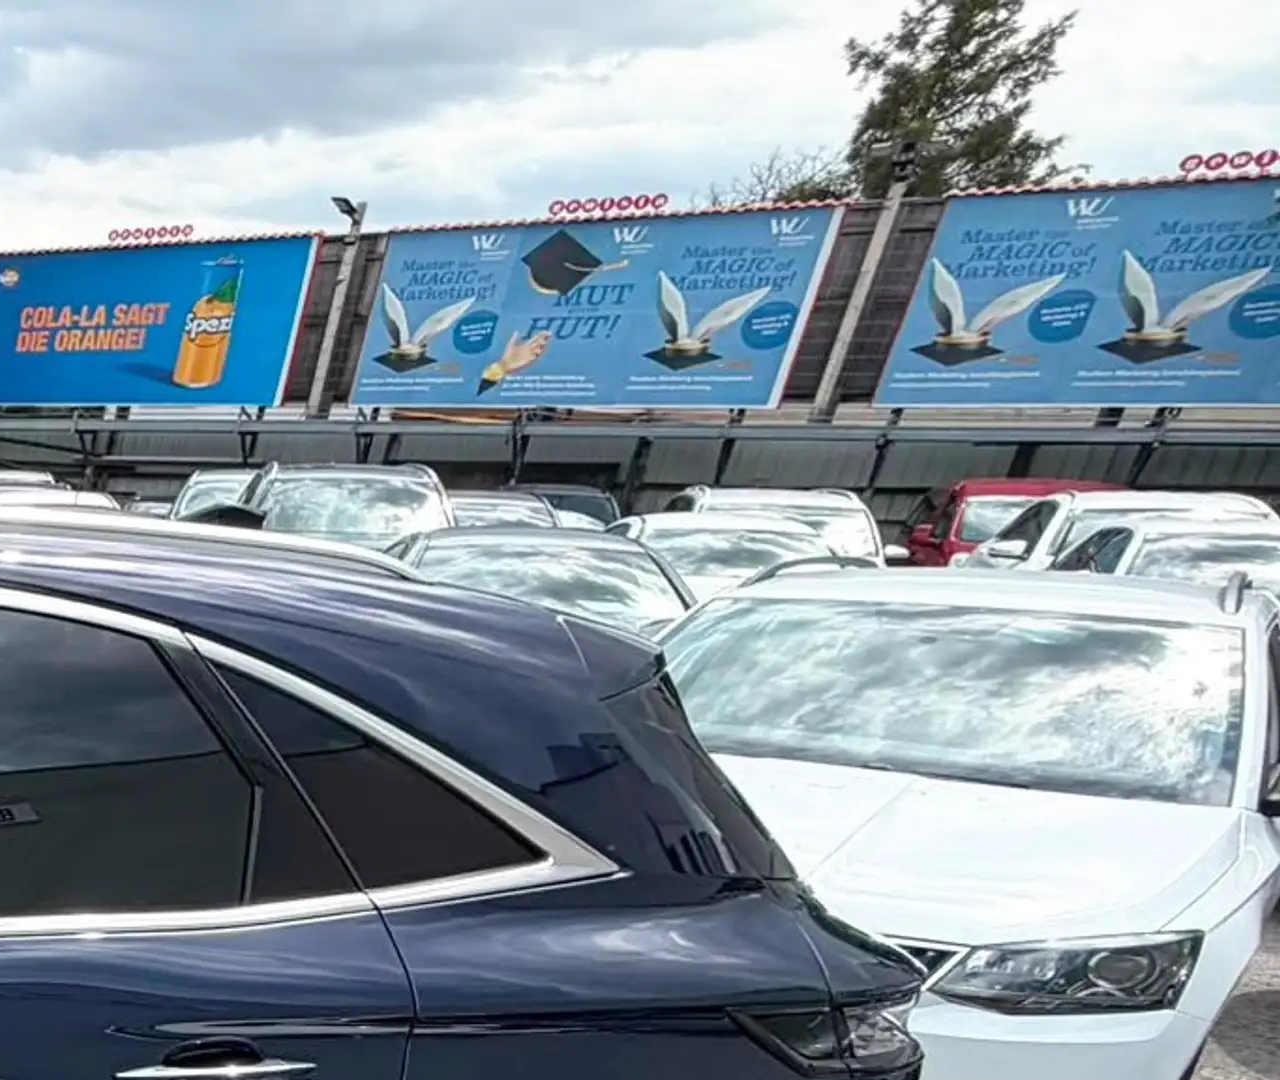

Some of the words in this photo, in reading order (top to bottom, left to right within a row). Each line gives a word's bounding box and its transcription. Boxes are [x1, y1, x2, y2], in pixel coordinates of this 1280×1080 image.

[961, 229, 1040, 244] Master
[681, 246, 749, 259] Master
[968, 241, 1071, 262] MAGIC
[690, 257, 774, 275] MAGIC
[775, 259, 794, 274] of
[408, 270, 479, 287] MAGIC
[553, 283, 636, 307] MUT
[20, 305, 107, 330] COLA-LA
[113, 303, 171, 328] SAGT
[184, 312, 233, 341] Spezi
[520, 314, 622, 340] HUT!
[16, 330, 50, 353] DIE
[54, 328, 146, 352] ORANGE!
